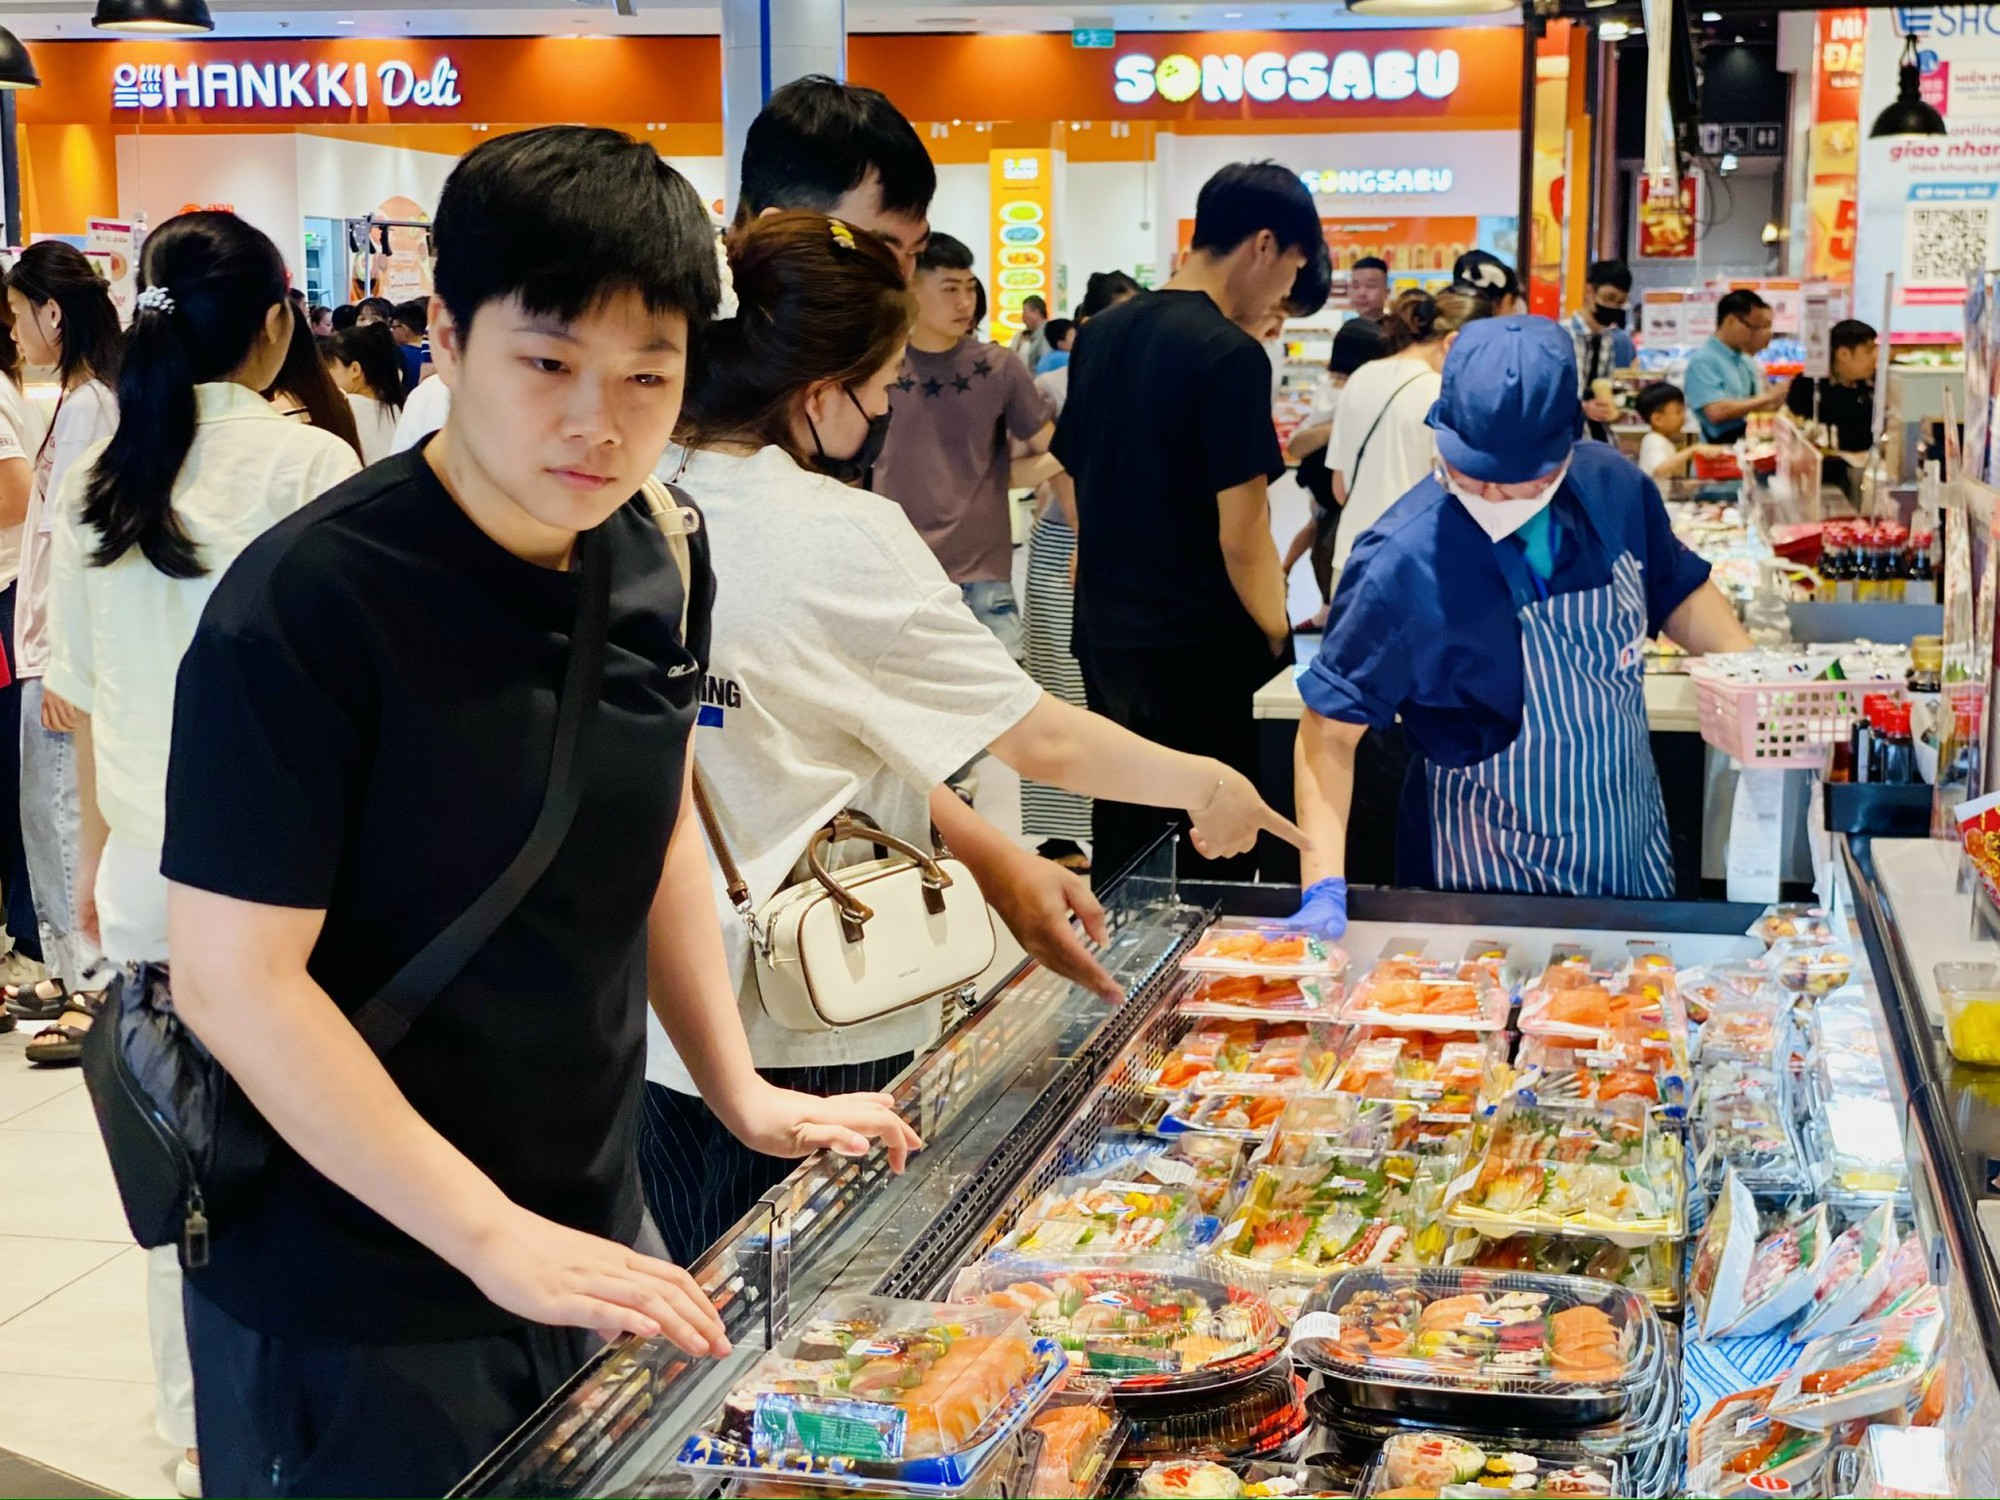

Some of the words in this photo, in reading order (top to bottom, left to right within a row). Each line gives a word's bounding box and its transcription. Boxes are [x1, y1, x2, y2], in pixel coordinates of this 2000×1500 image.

[162, 62, 368, 108] HANKKI
[376, 57, 462, 106] Deli
[1113, 48, 1460, 103] SONGSABU
